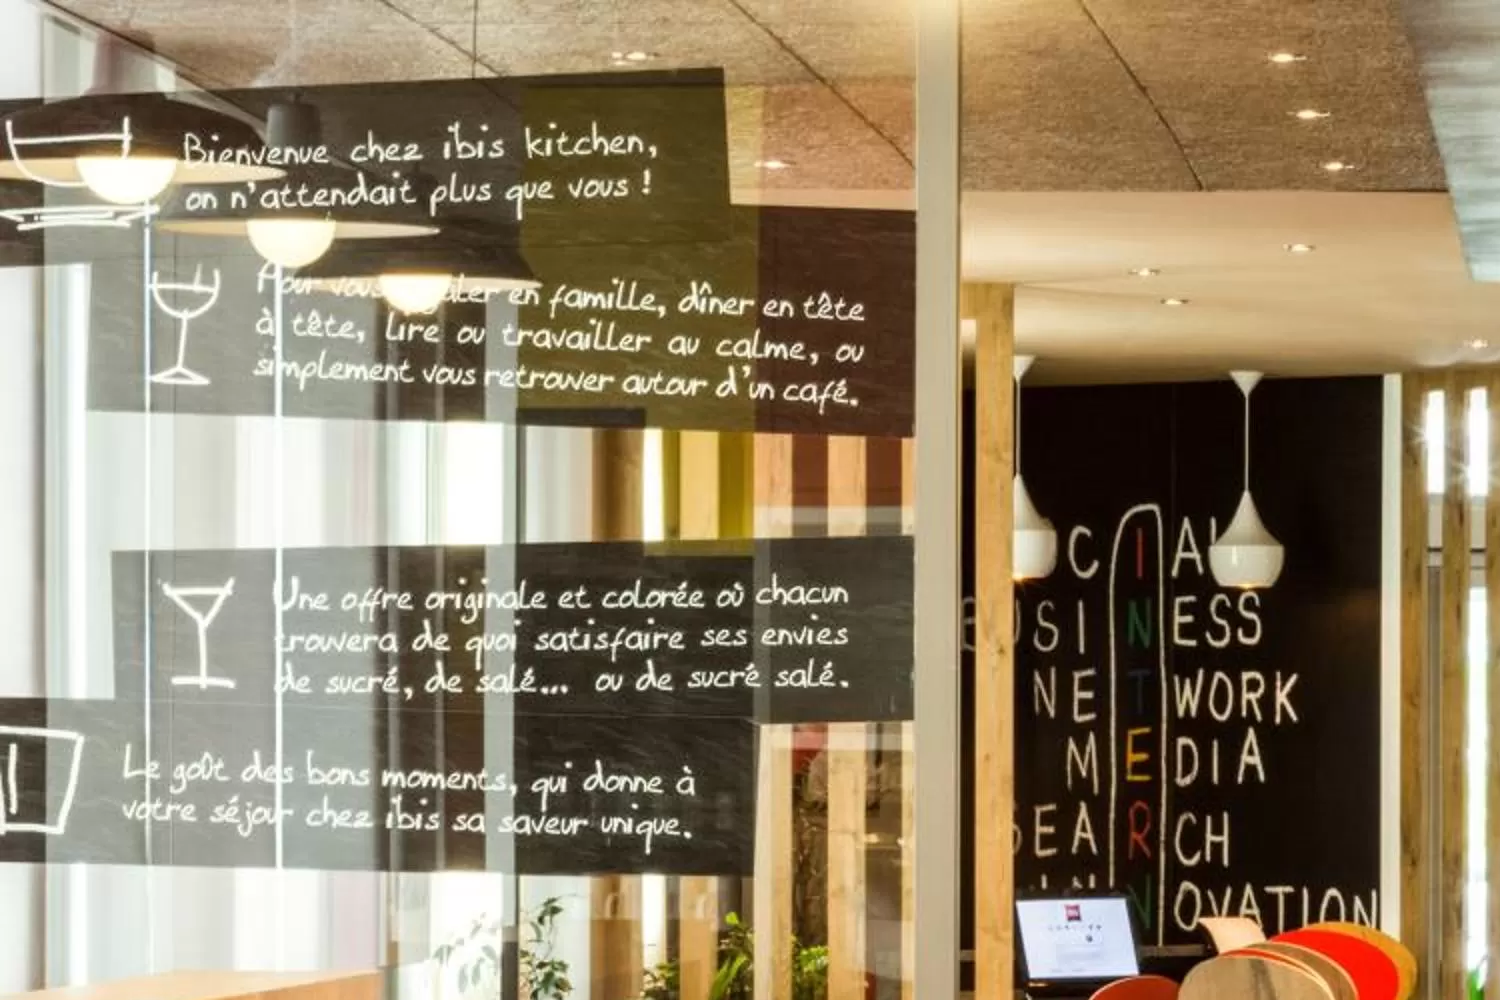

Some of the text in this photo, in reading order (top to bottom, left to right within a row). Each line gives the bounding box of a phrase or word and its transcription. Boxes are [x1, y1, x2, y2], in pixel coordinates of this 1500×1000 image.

[184, 121, 657, 167] Bienvenue chez ibis kitchen,
[185, 191, 217, 211] on
[231, 171, 416, 209] n'attendait
[430, 172, 491, 217] plus
[505, 181, 554, 220] que
[568, 177, 629, 198] vous
[257, 261, 315, 296] Pour
[330, 277, 384, 298] vous
[508, 287, 539, 305] en
[549, 277, 667, 319] famille,
[678, 281, 754, 316] dîner
[763, 297, 794, 318] en
[803, 291, 865, 321] tête
[255, 307, 864, 365] à tête, lire ou travailler au calme, ou
[253, 347, 859, 415] simplement vous retrouver autour d'un café.
[273, 572, 849, 624] Une offre originale et colorée où chacun
[275, 613, 849, 671] trouvera de quoi satisfaire ses envies
[274, 658, 849, 700] de sucré, de salé... ou de sucré salé.
[123, 742, 696, 812] Le goût des bons moments, qui donne à
[122, 794, 692, 855] votre séjour chez ibis sa saveur unique.
